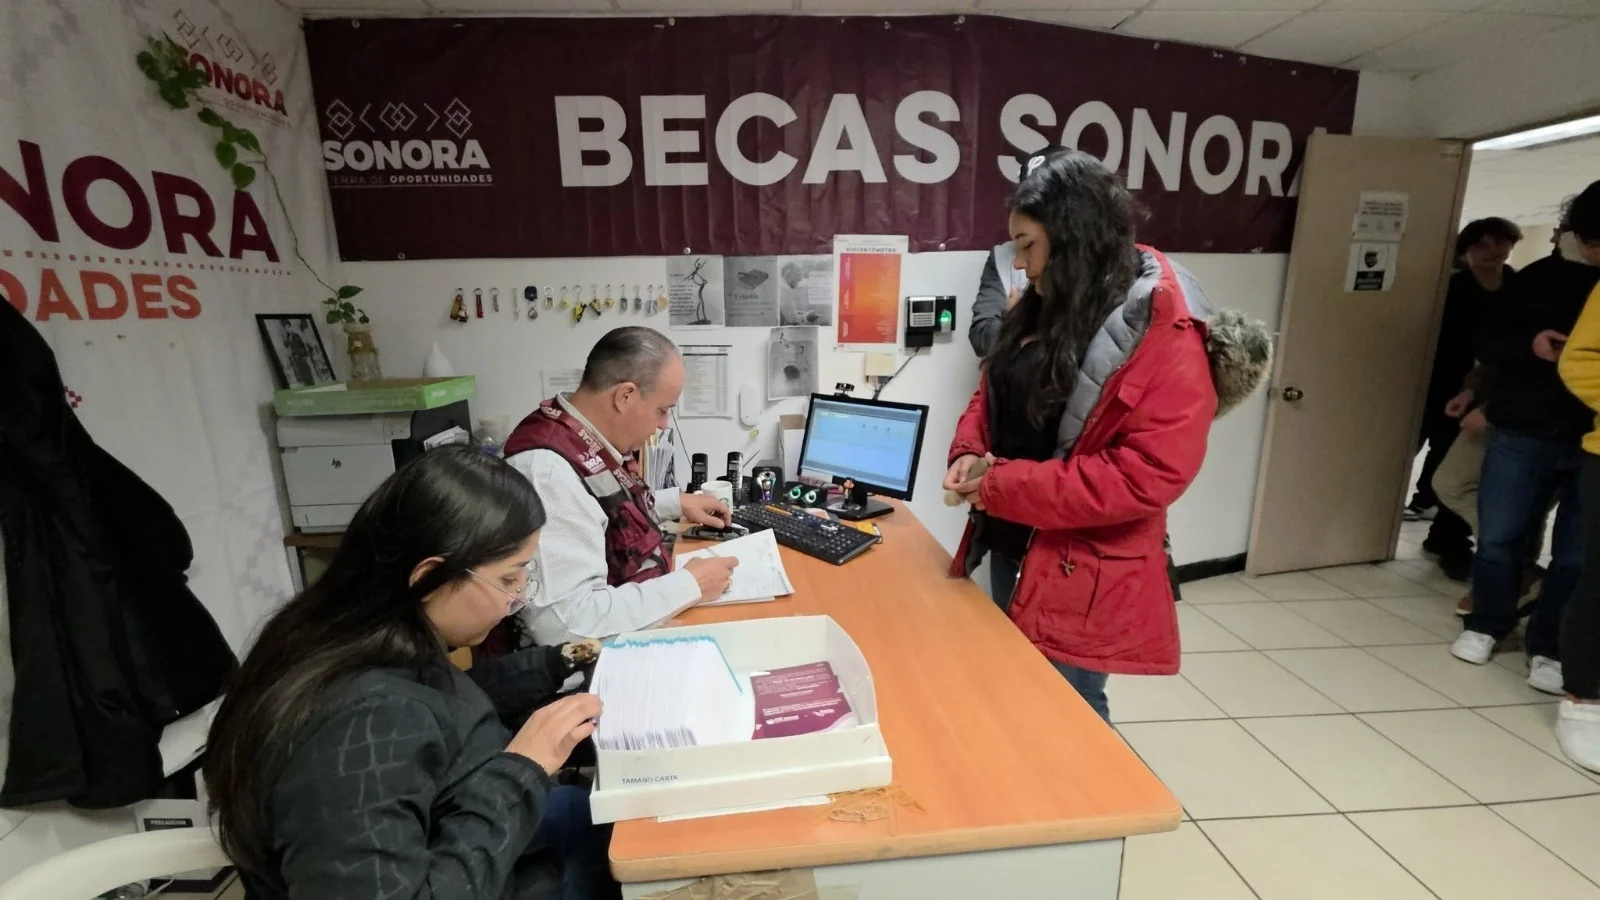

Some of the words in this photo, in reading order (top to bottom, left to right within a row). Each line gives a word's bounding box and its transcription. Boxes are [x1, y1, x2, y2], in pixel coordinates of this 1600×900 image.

[323, 138, 491, 171] SONORA
[554, 90, 961, 188] BECAS
[997, 93, 1301, 198] SONOR
[389, 174, 493, 184] OPORTUNIDADES
[655, 775, 678, 783] CARTA
